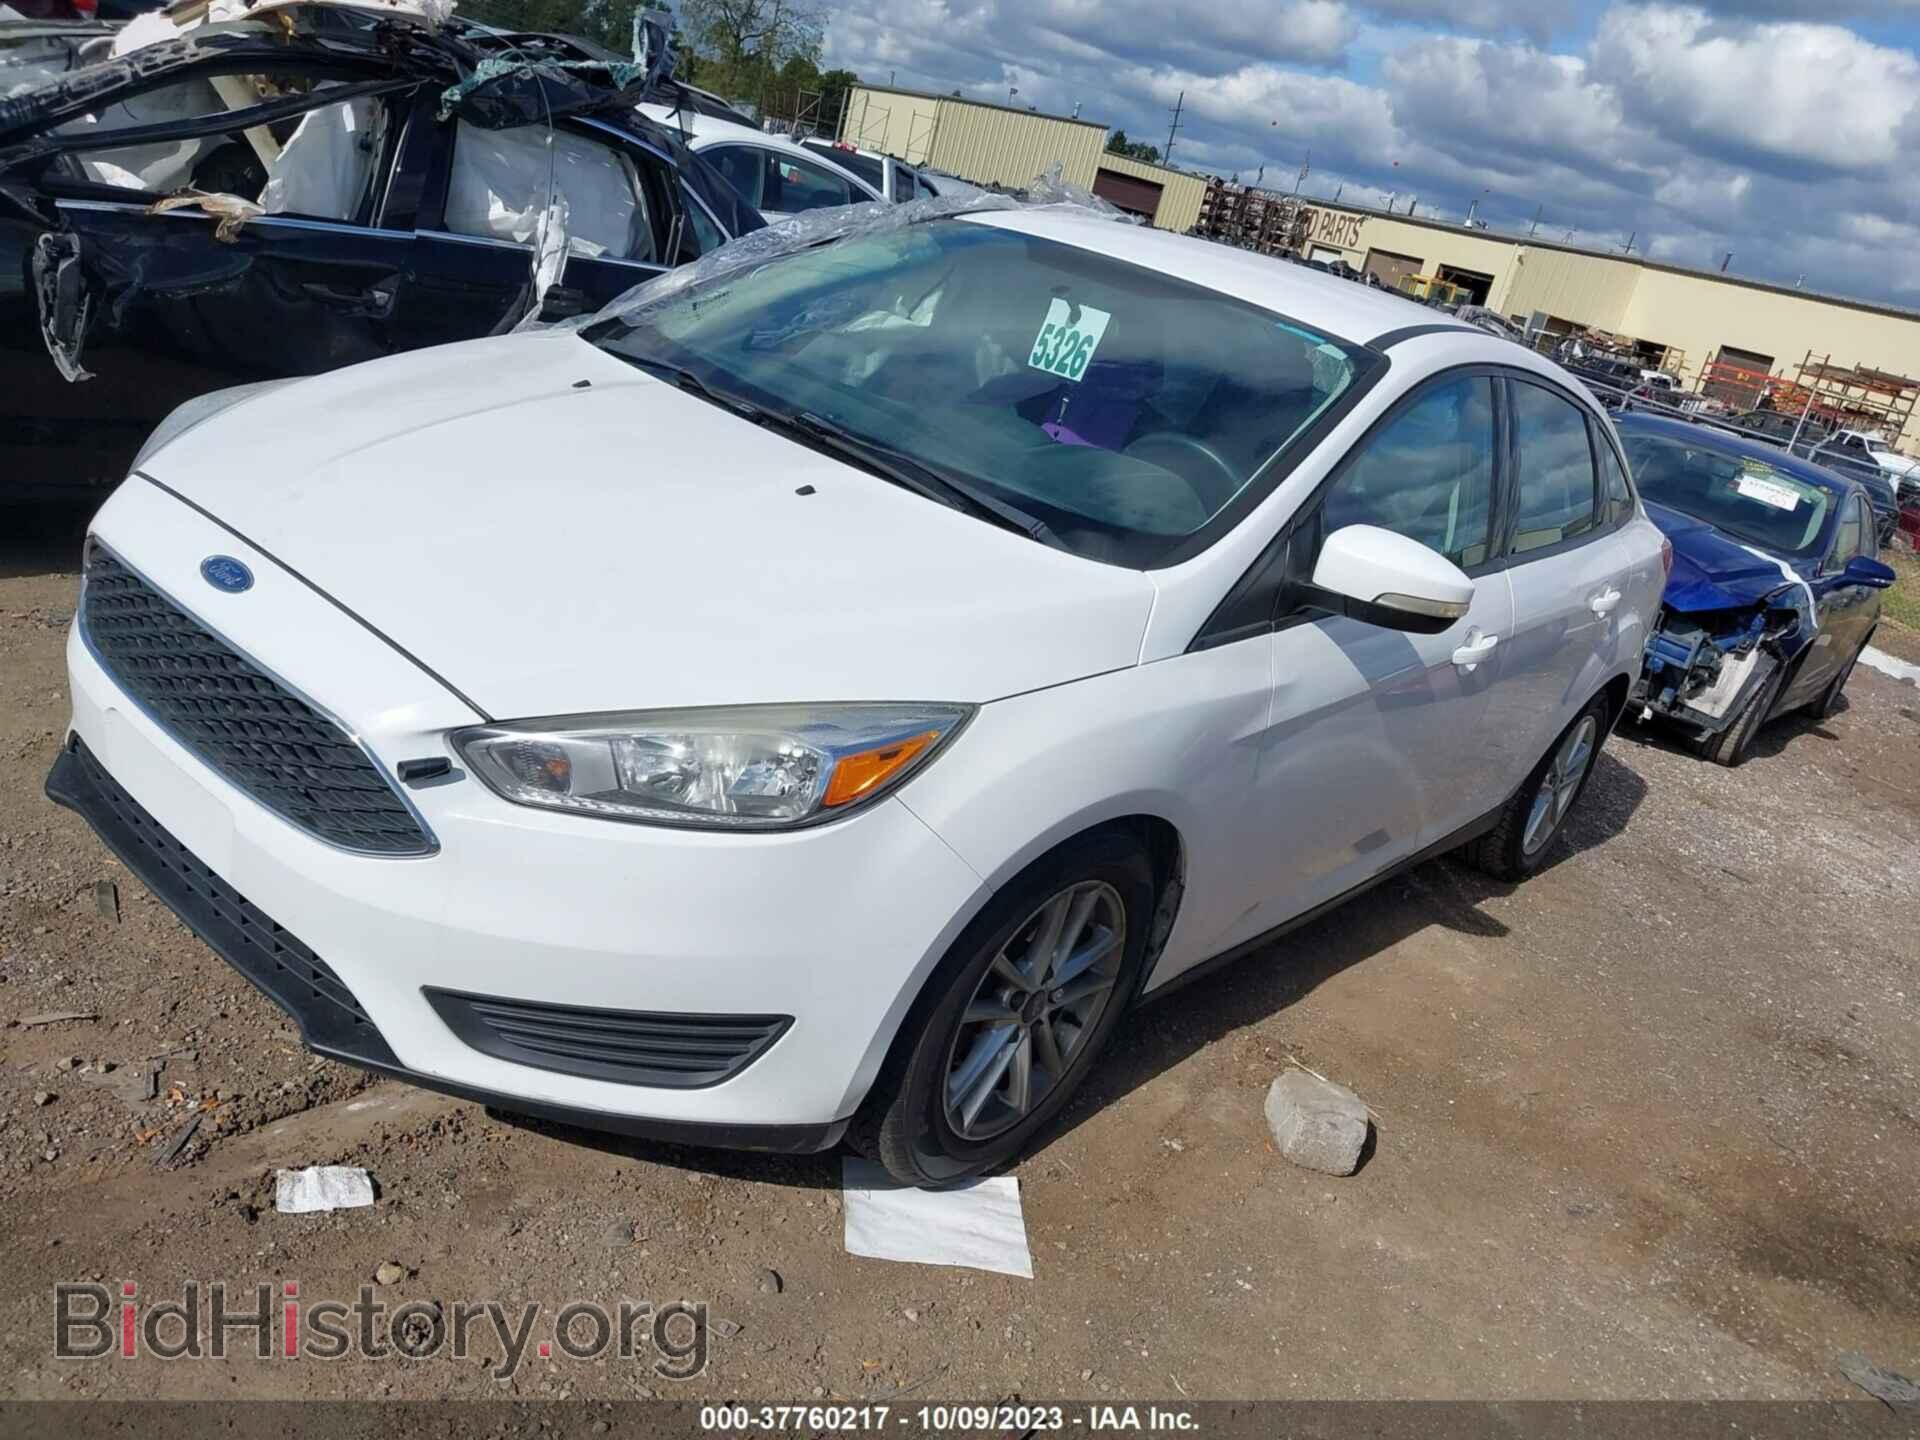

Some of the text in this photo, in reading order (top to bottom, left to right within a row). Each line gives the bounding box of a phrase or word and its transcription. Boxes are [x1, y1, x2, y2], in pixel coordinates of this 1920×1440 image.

[1318, 211, 1361, 247] PARTS
[1031, 323, 1094, 377] 5326
[207, 561, 242, 586] Ford
